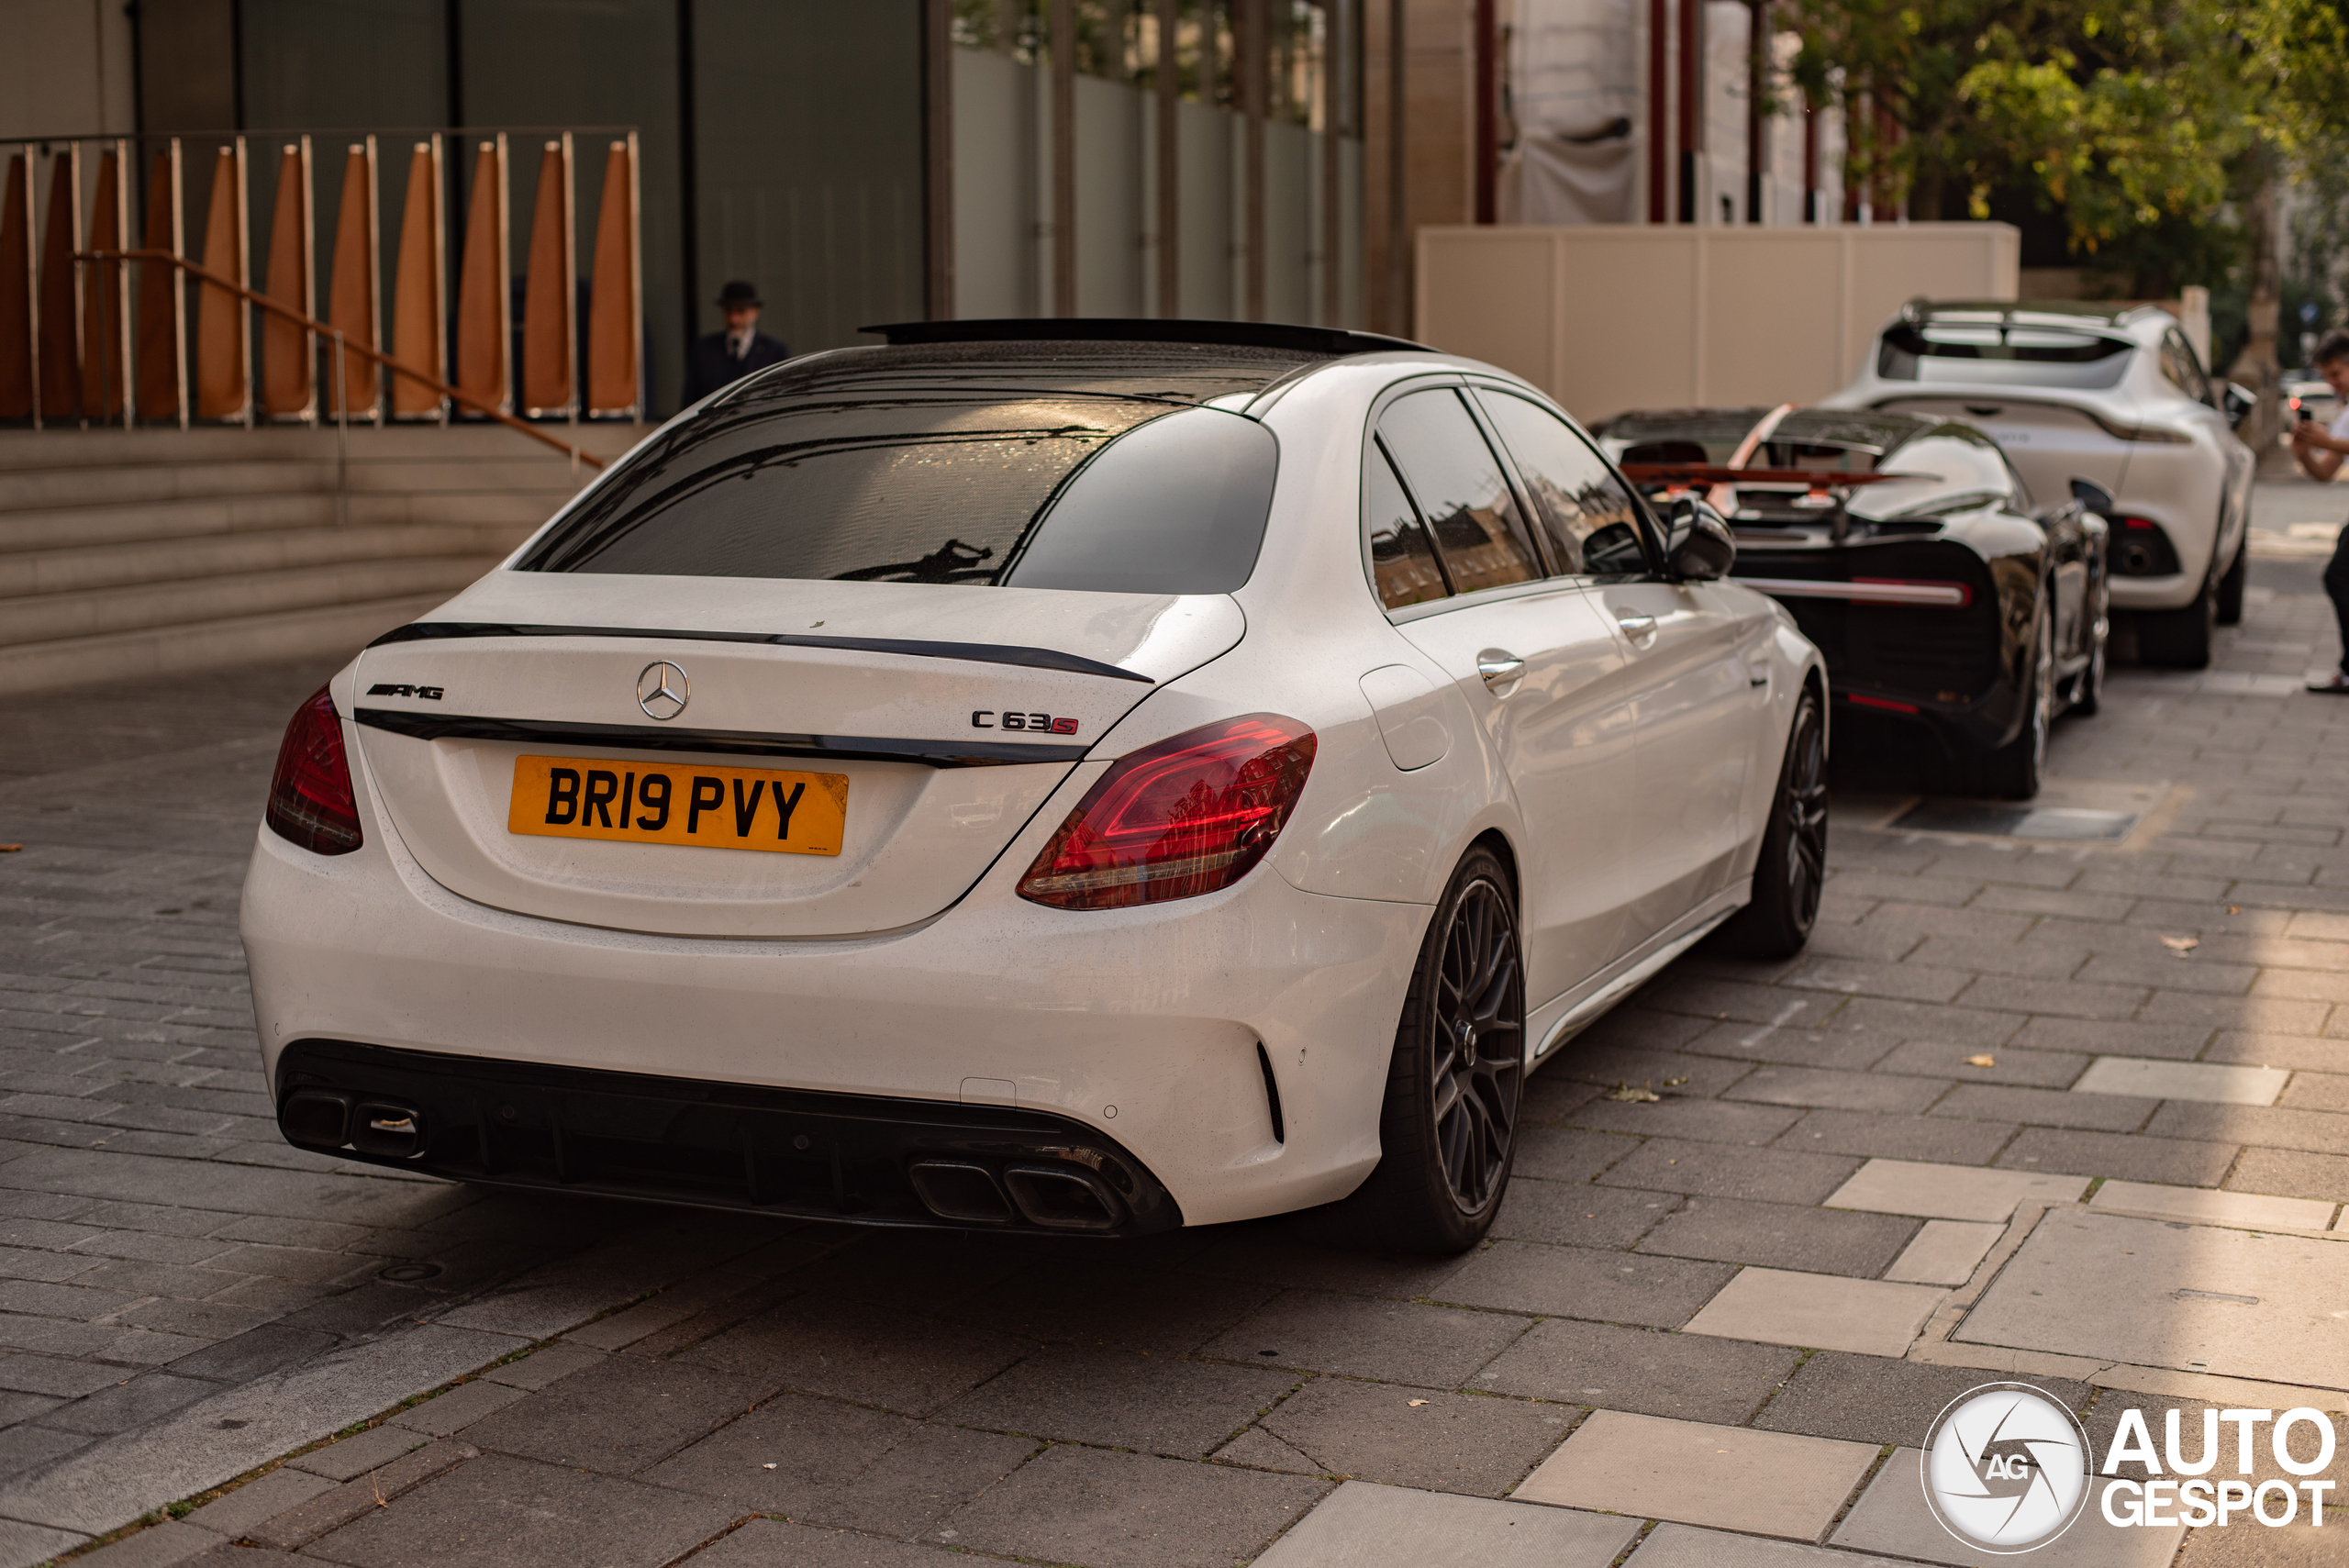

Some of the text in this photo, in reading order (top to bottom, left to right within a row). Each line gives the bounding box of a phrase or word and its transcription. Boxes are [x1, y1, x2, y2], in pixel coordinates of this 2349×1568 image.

[388, 684, 444, 700] AMG
[972, 710, 995, 728] C
[545, 767, 806, 840] BR19 PVY
